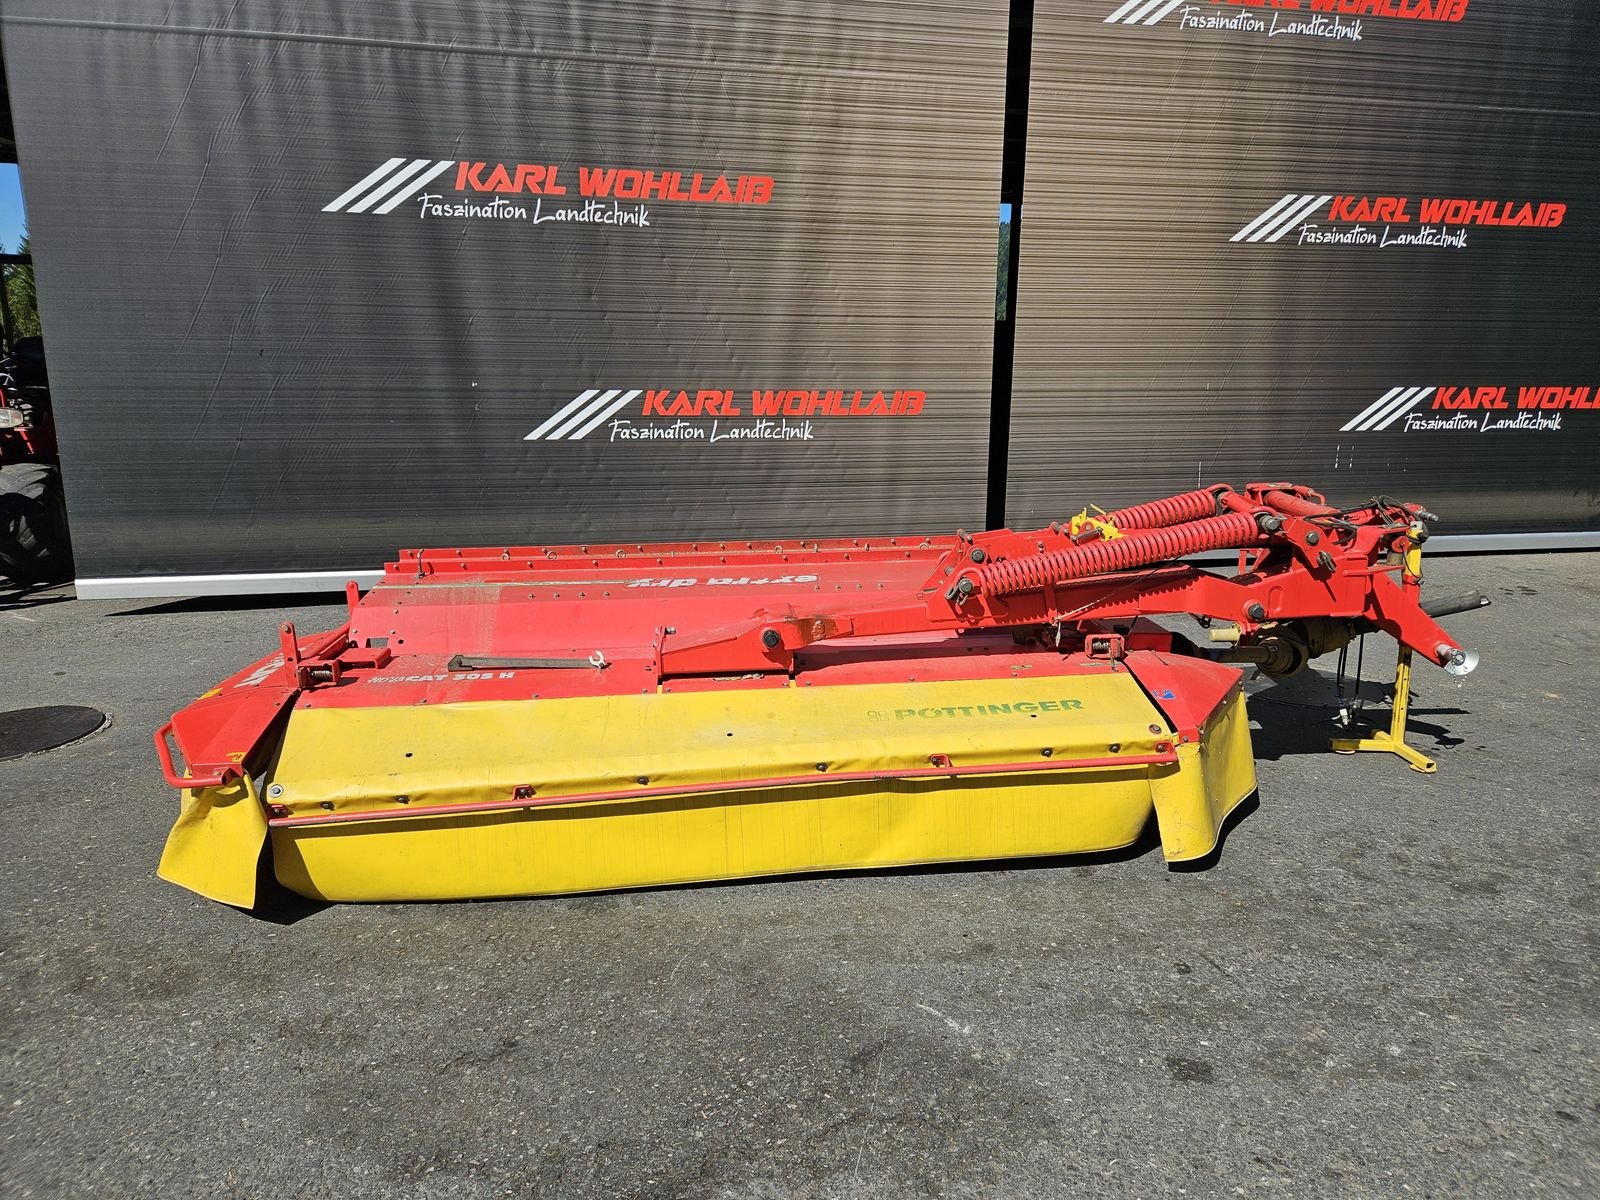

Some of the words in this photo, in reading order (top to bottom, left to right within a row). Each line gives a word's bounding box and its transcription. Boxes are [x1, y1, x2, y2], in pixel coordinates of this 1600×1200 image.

[1179, 5, 1264, 31] Faszination
[1269, 12, 1362, 41] Landtechnik
[455, 161, 566, 196] KARL
[418, 192, 526, 220] Faszination
[533, 198, 649, 227] Landtechnik
[1328, 195, 1410, 223] KARL
[1297, 223, 1376, 246] Faszination
[1380, 225, 1467, 249] Landtechnik
[642, 390, 740, 417] KARL
[1432, 386, 1509, 410] KARL
[607, 418, 704, 442] Faszination
[710, 418, 814, 442] Landtechnik
[1403, 411, 1478, 433] Faszination
[1480, 410, 1562, 433] Landtechnik
[452, 672, 494, 681] 305
[498, 671, 516, 679] H
